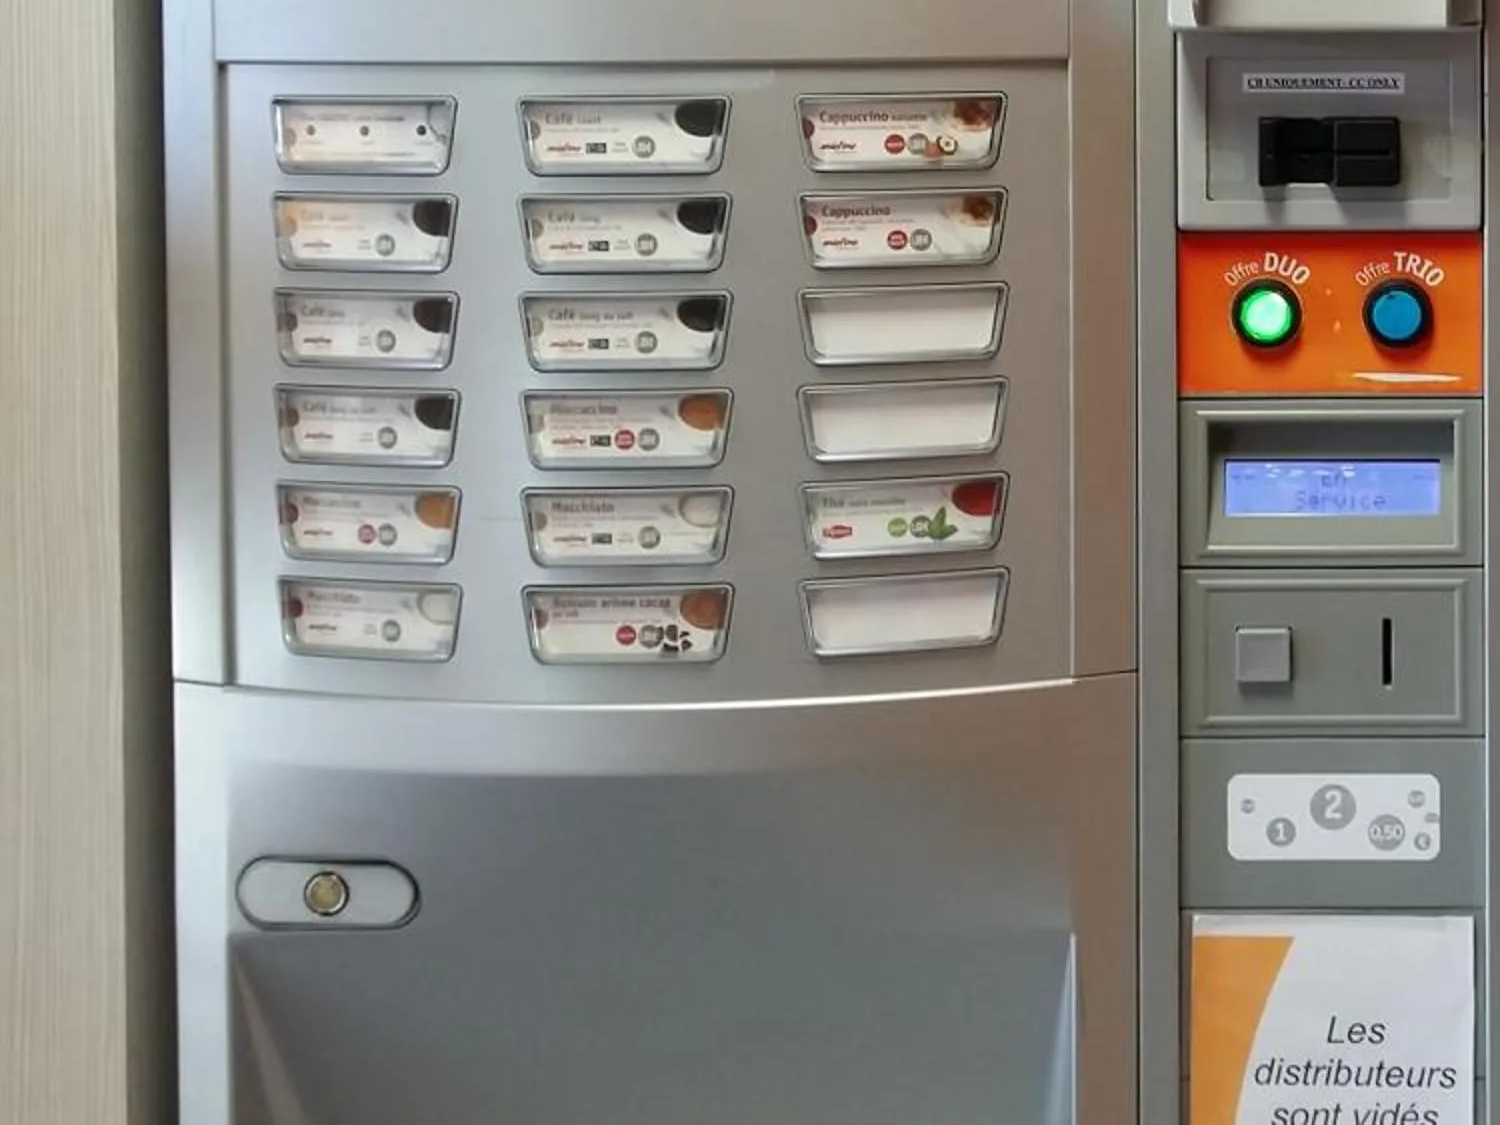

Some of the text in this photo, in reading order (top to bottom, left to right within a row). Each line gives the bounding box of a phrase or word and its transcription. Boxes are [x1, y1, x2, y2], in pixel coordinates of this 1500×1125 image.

[819, 111, 889, 124] Cappuccino
[822, 205, 891, 218] Cappuccino
[1225, 252, 1311, 286] Offre DUO
[1355, 251, 1445, 287] Offre TRIO
[1296, 490, 1386, 510] Service
[1324, 790, 1342, 819] 2
[1276, 824, 1286, 839] 1
[1327, 1015, 1386, 1045] Les
[1254, 1058, 1457, 1090] distributeurs
[1271, 1100, 1439, 1125] sont vidés
